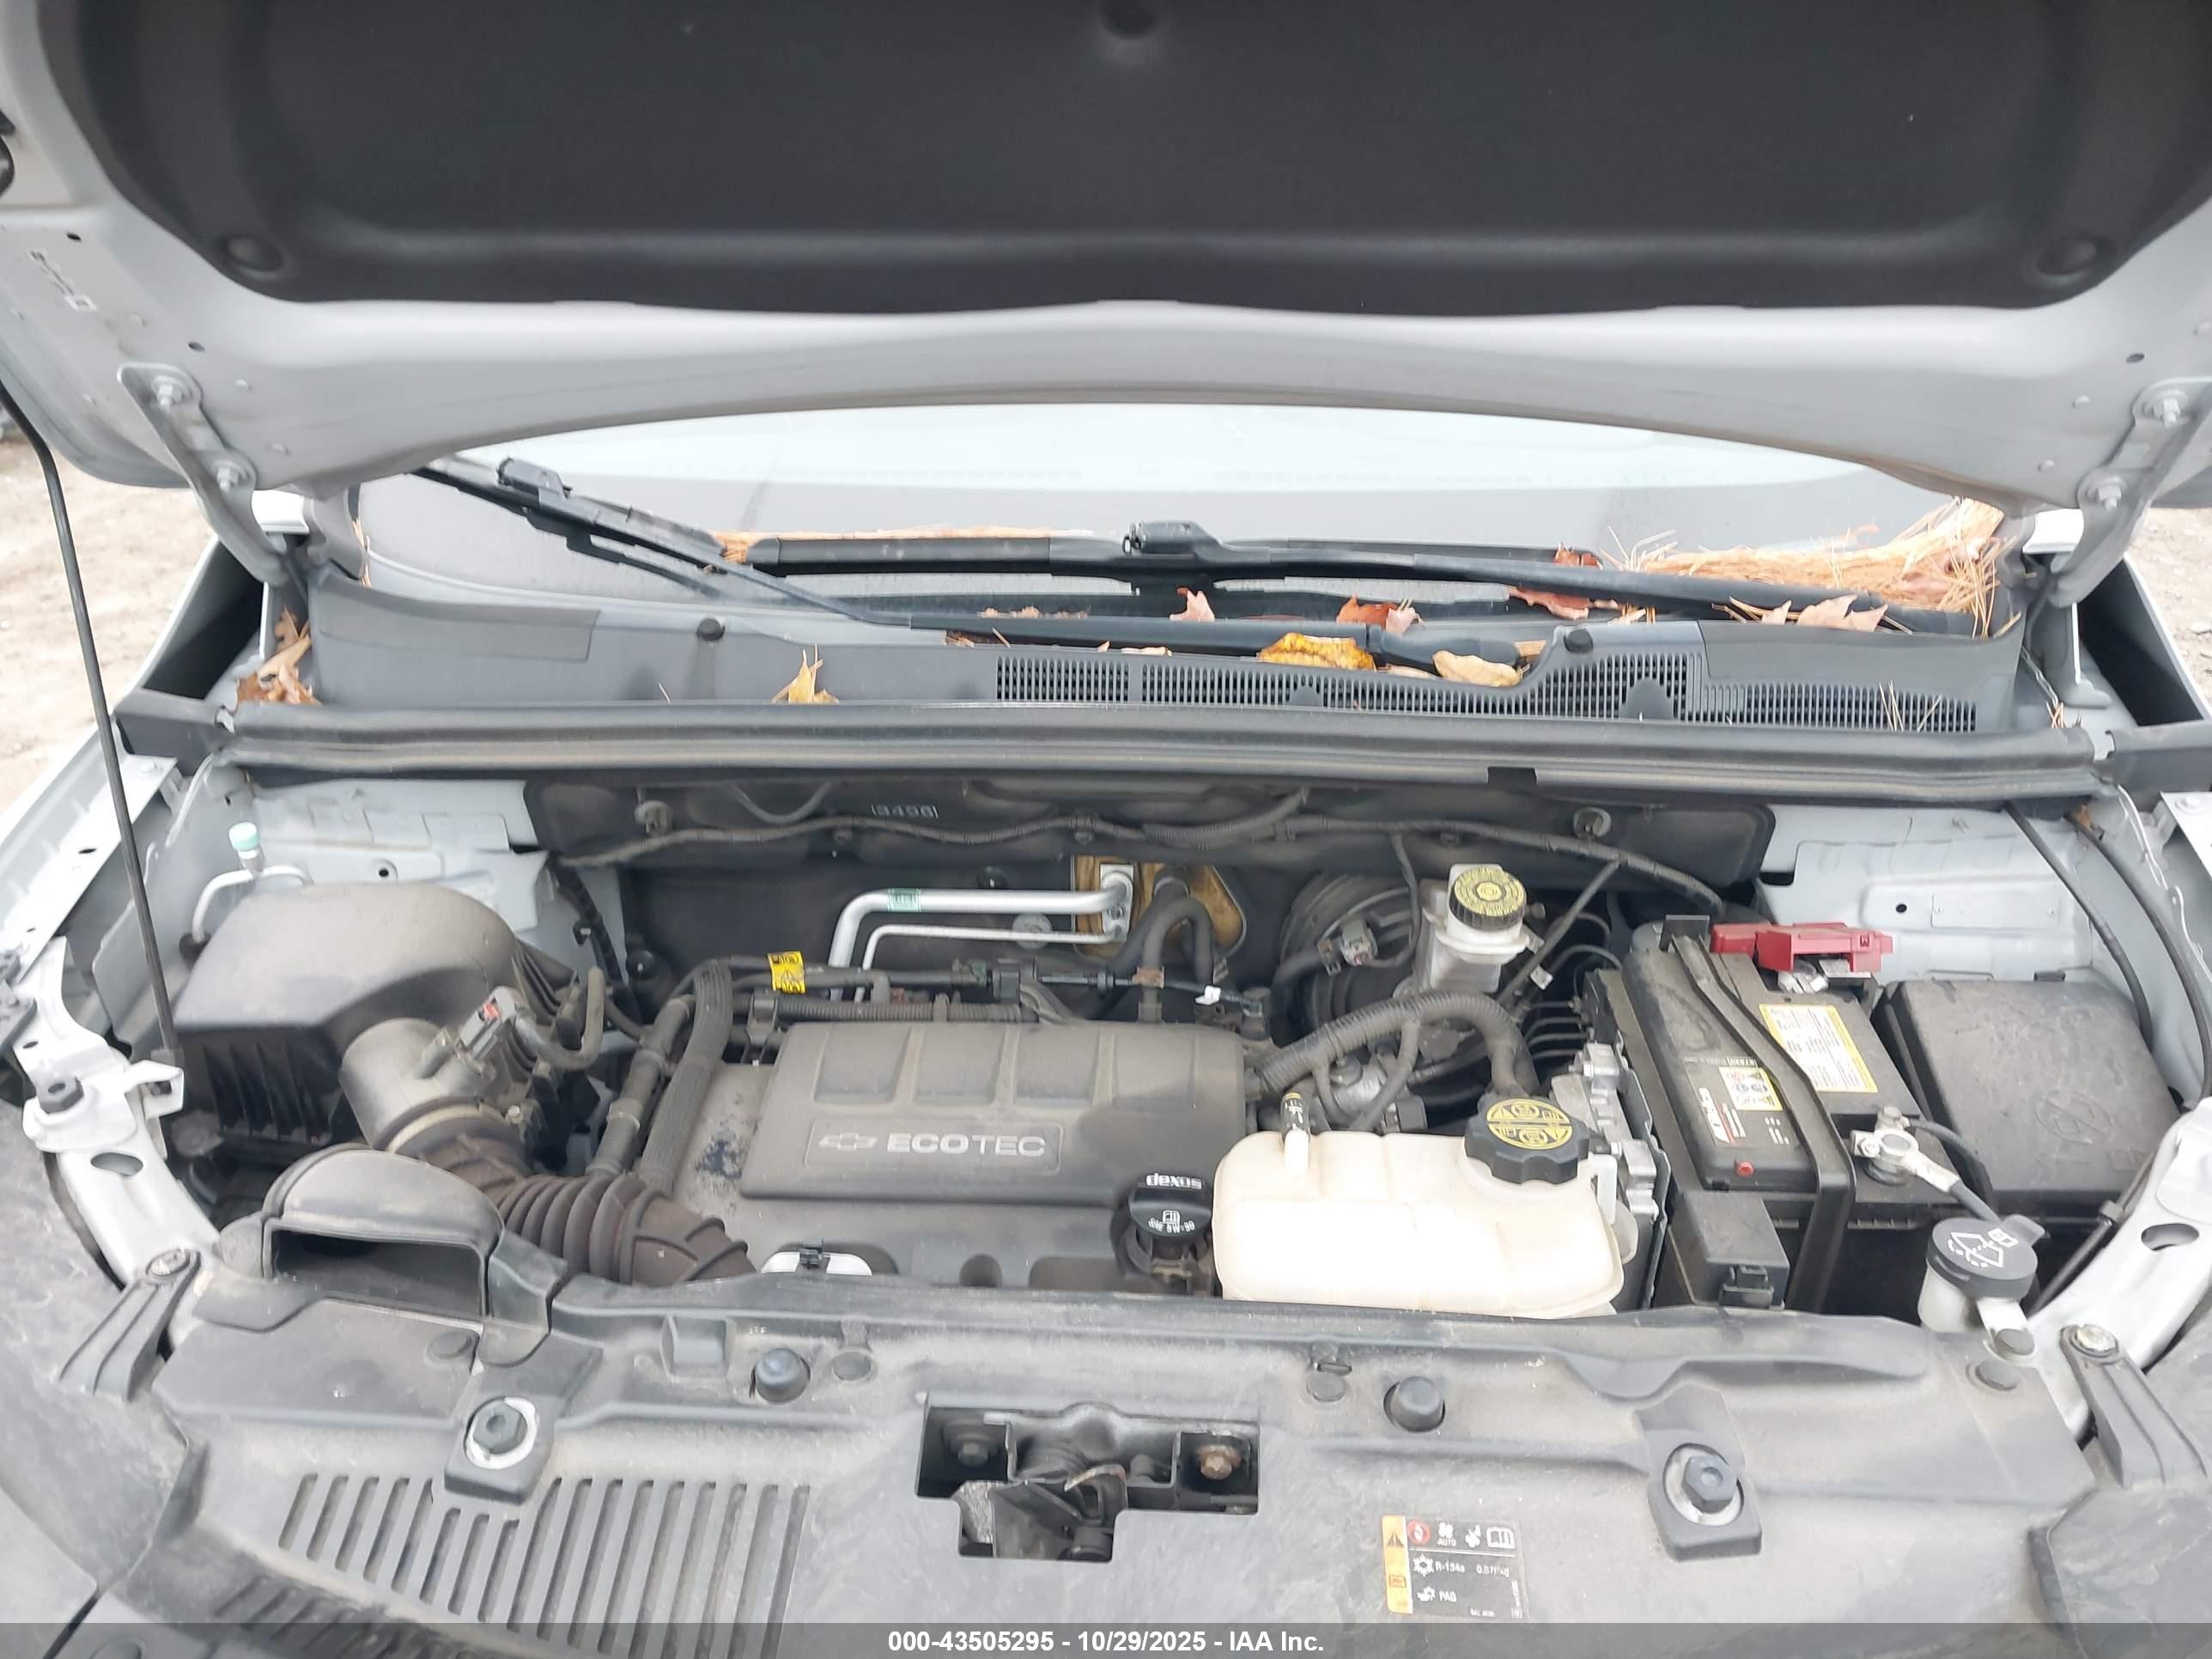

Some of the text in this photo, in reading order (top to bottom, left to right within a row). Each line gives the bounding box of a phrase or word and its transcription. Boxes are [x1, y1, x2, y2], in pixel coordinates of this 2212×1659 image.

[886, 1133, 1046, 1157] ECOTEC
[1146, 1173, 1202, 1189] dexos
[1437, 1538, 1457, 1547] AUTO
